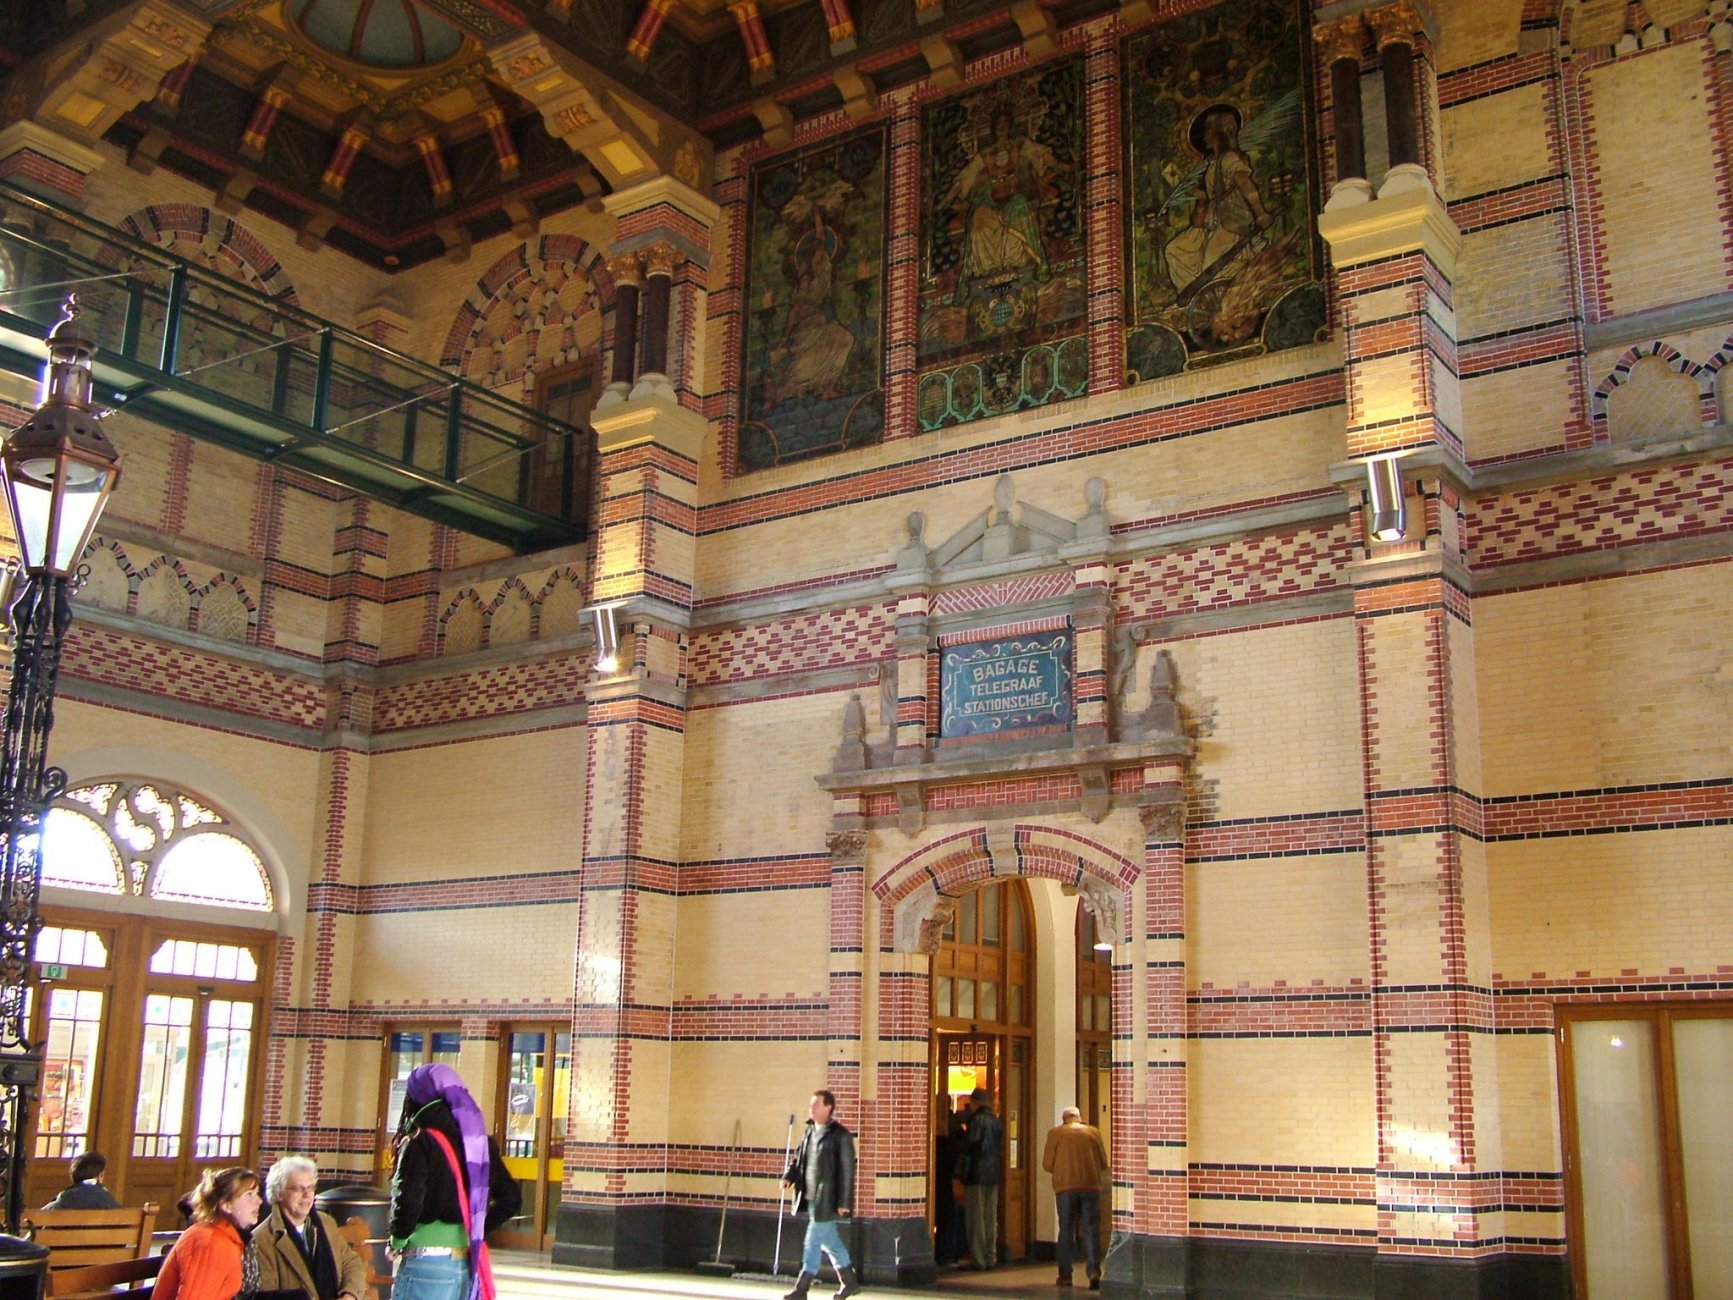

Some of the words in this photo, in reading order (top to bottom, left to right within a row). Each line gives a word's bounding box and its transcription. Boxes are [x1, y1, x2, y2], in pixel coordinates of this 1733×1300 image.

[972, 659, 1040, 682] BAGAGE
[969, 675, 1044, 697] TELEGRAAF
[964, 691, 1049, 714] STATIONSCHEF
